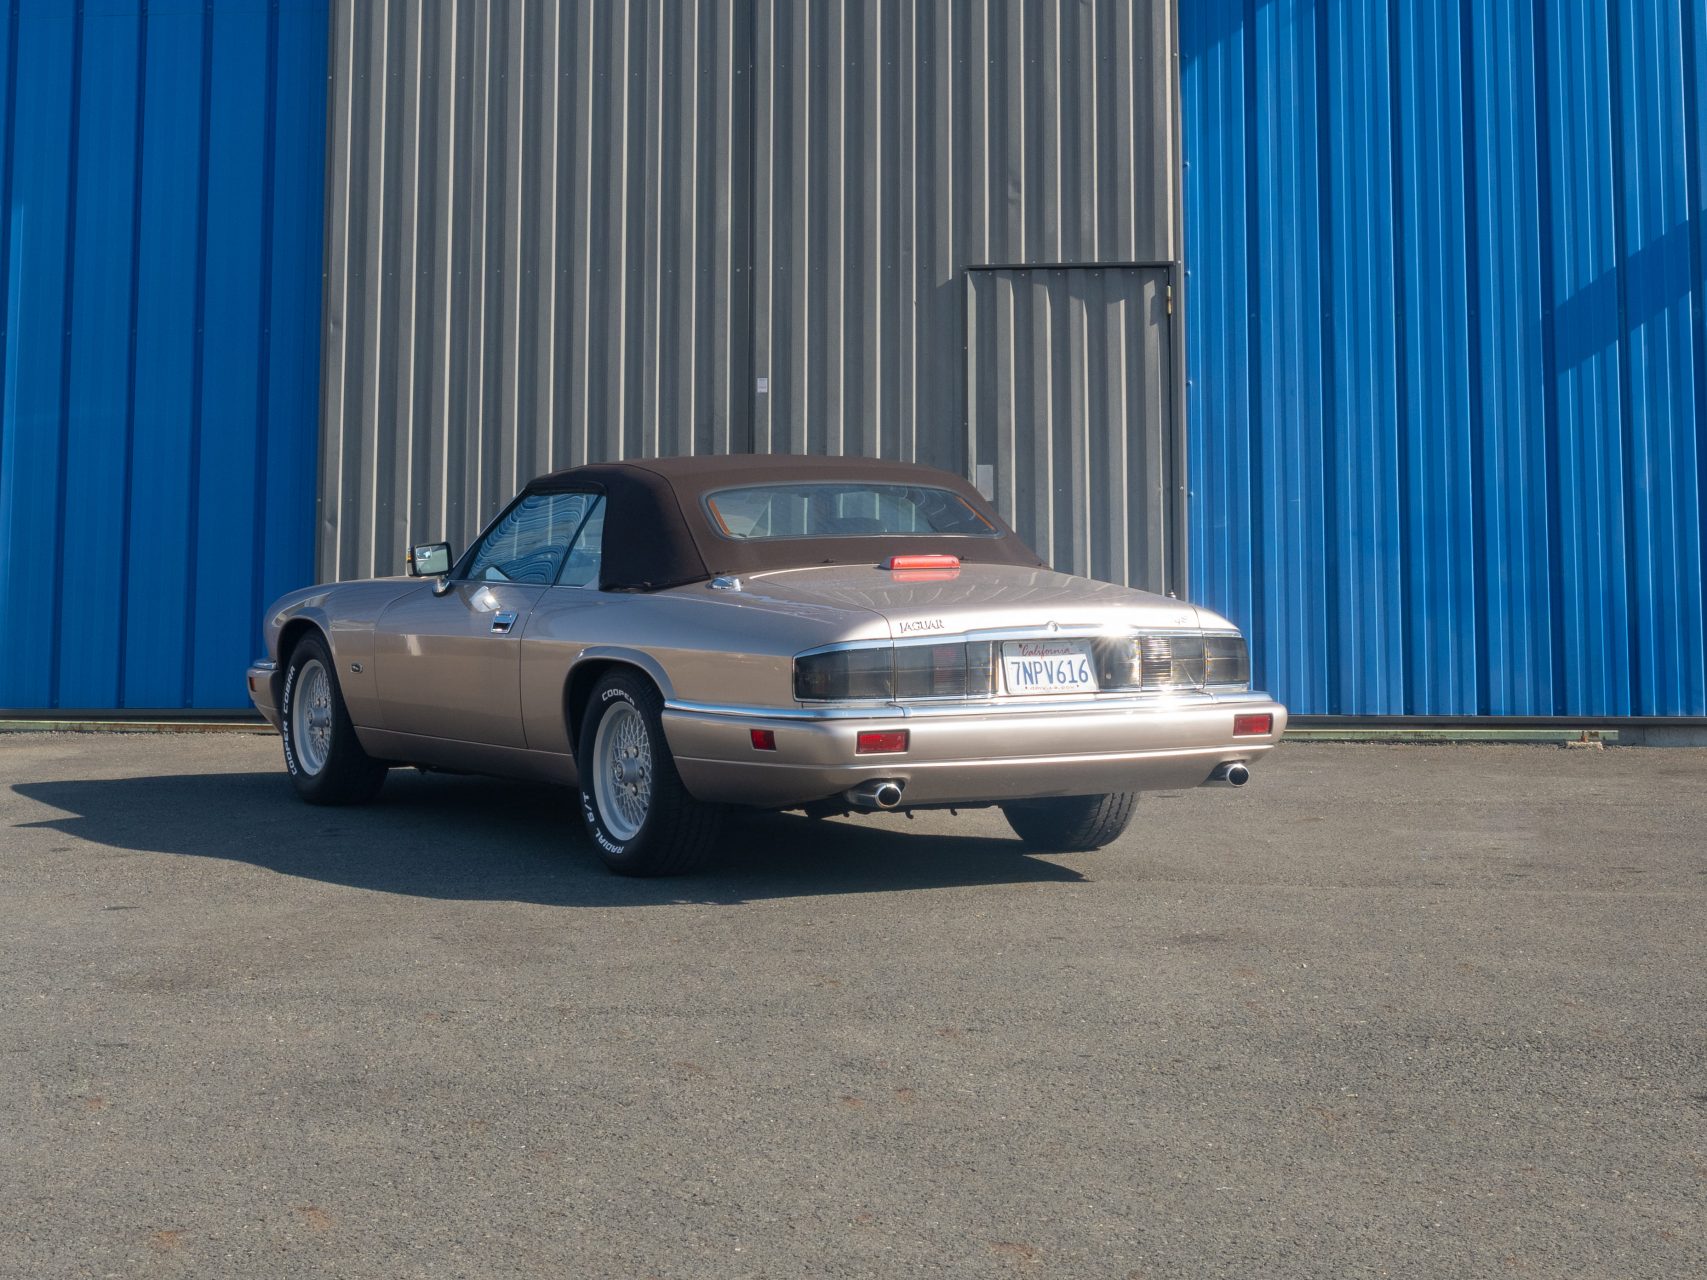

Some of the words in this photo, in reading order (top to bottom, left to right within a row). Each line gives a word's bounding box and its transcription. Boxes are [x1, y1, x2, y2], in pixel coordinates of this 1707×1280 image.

[899, 619, 945, 634] JAGUAR
[1021, 644, 1074, 659] California
[1011, 659, 1089, 686] 7NPV616
[283, 665, 296, 714] COBRA
[601, 688, 635, 706] COOPER
[283, 720, 298, 776] COOPER
[594, 827, 625, 854] RADIAL
